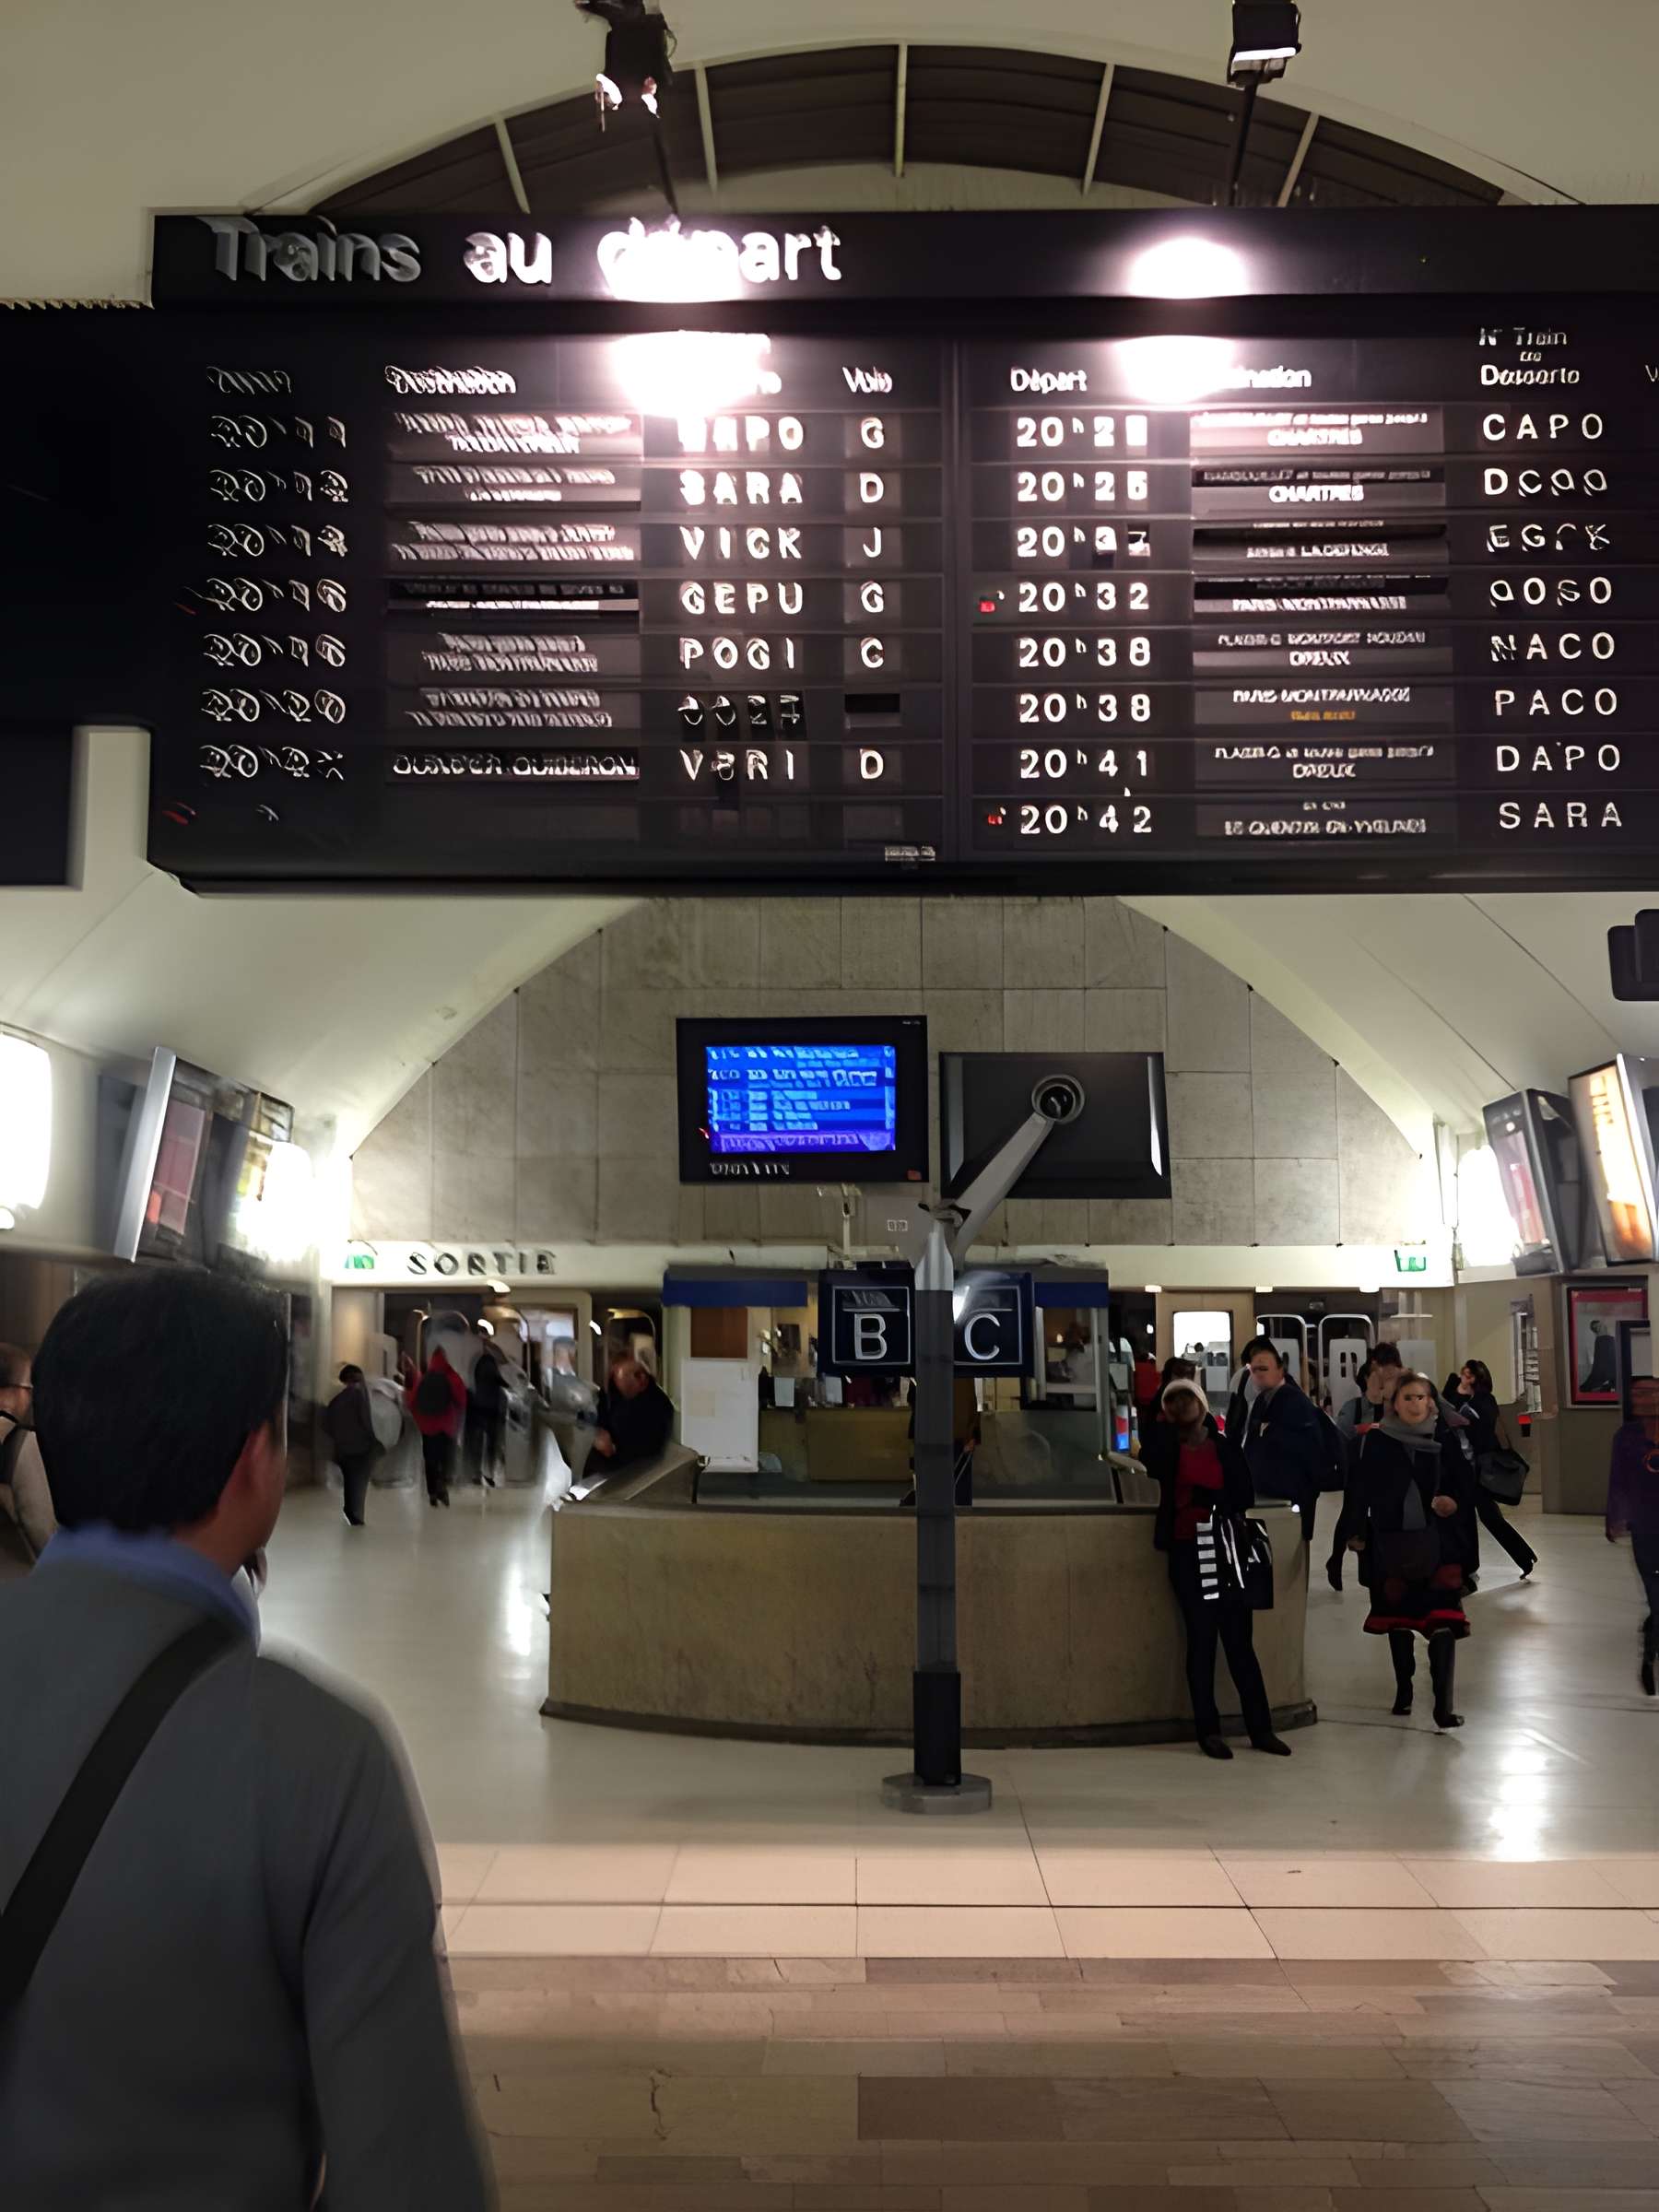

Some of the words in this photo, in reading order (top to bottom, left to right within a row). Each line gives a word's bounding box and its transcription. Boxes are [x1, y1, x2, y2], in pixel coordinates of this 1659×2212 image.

[198, 216, 421, 282] Trains
[464, 232, 552, 284] au
[1482, 414, 1604, 441] CAPO
[859, 472, 884, 503] D
[863, 527, 881, 558] J
[1494, 688, 1618, 715] PACO
[860, 748, 884, 780] D
[1497, 744, 1620, 772] DAPO
[1499, 801, 1622, 830] SARA
[406, 1251, 556, 1276] SORTIE
[854, 1313, 888, 1359] B
[964, 1312, 1001, 1359] C
